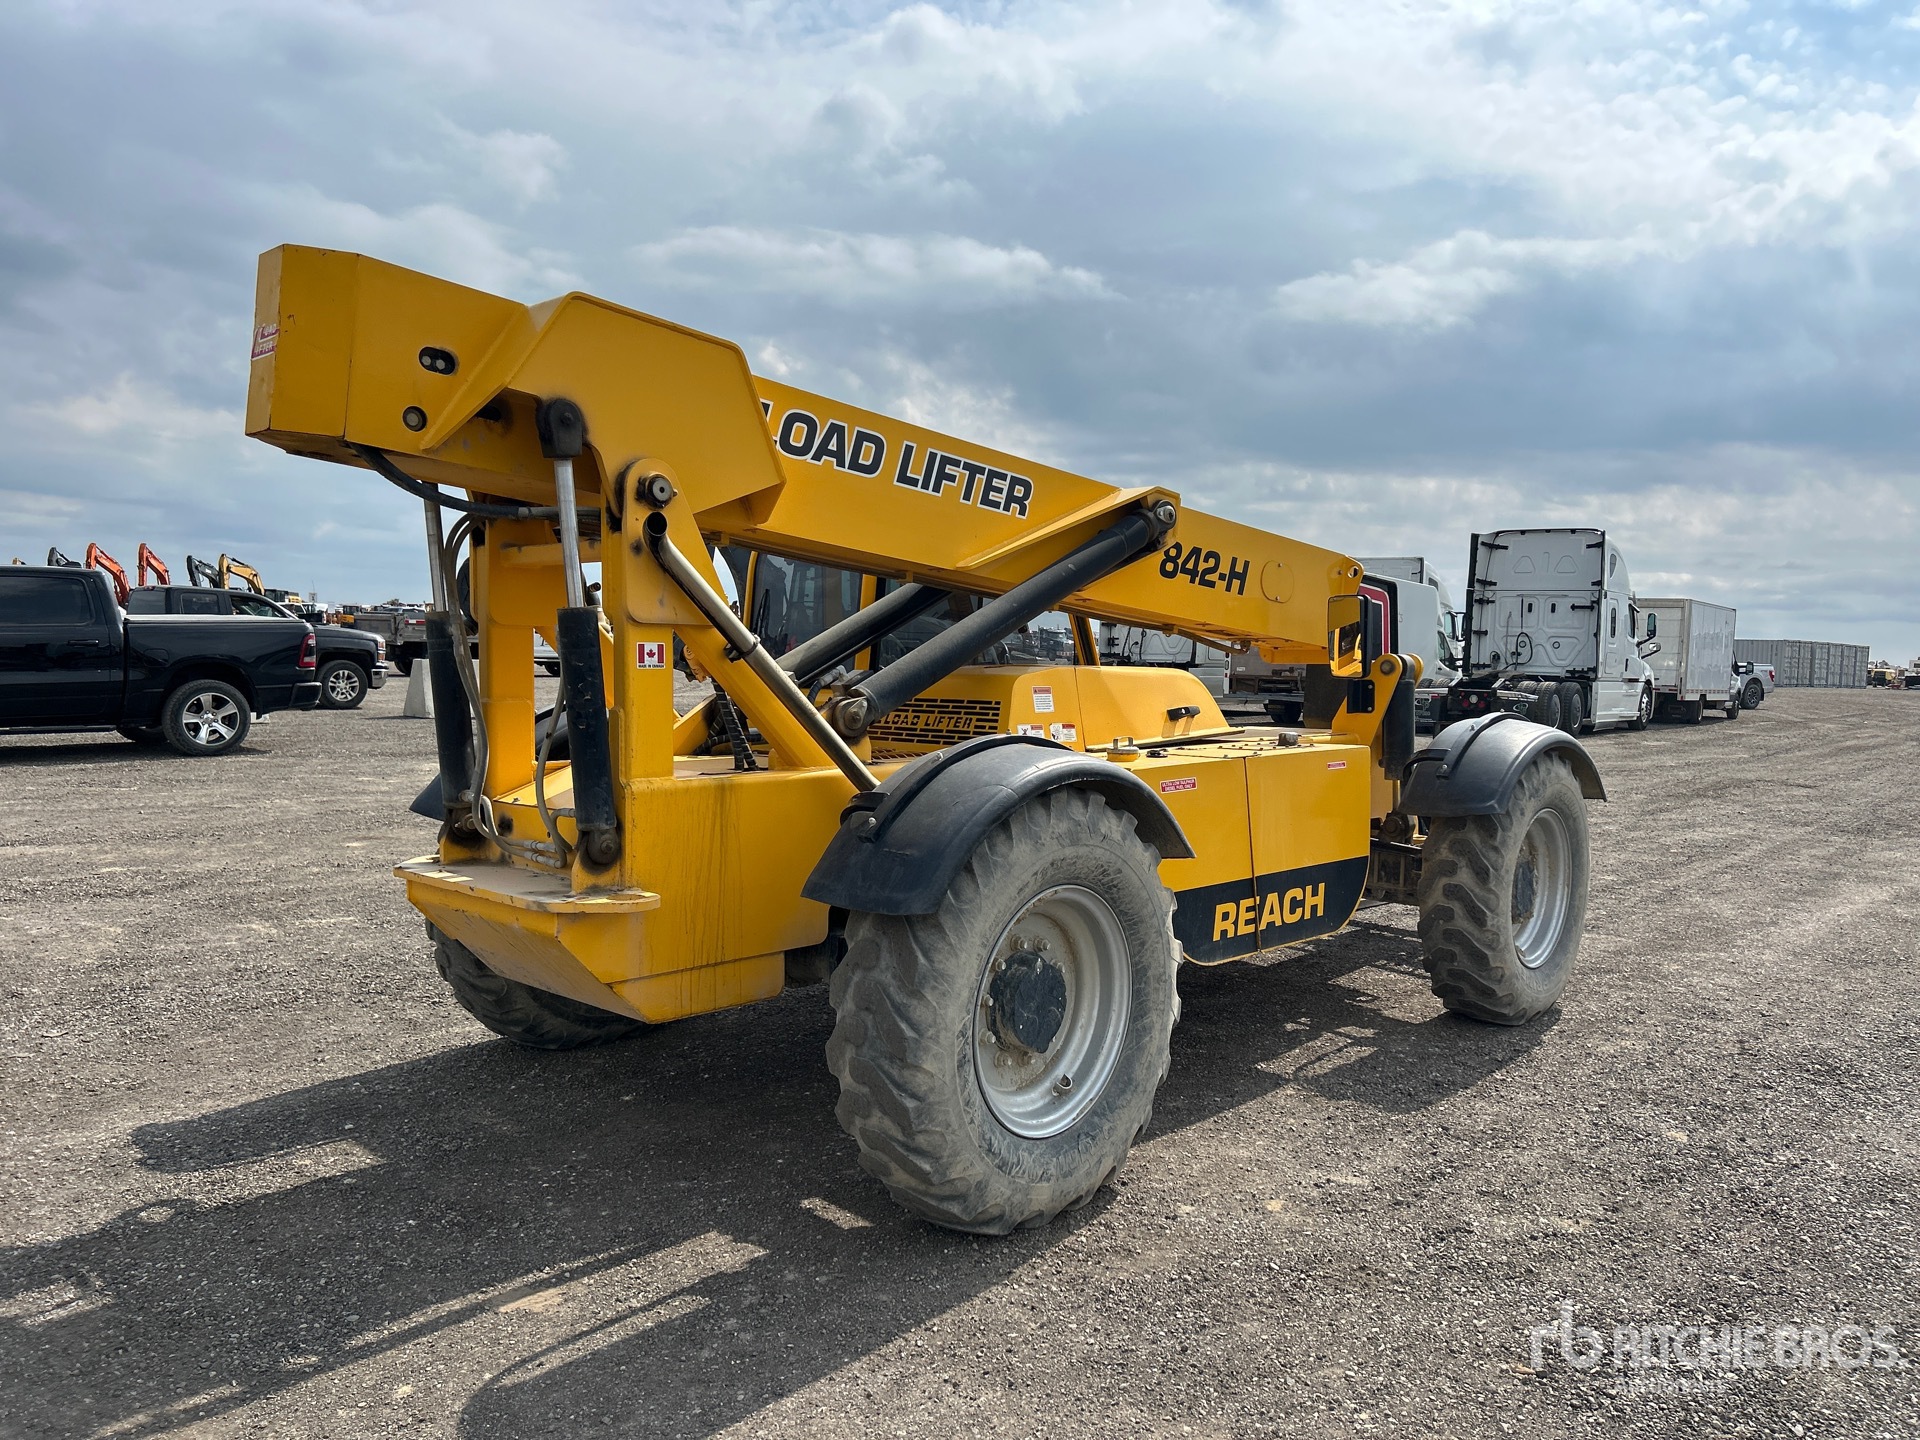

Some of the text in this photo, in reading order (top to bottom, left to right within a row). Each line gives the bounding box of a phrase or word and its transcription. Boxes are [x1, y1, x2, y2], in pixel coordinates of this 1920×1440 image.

[760, 399, 1033, 520] OAD LIFTER
[1159, 541, 1250, 596] 842-H
[883, 713, 973, 729] LOAD LIFTER
[1213, 882, 1325, 941] REACH
